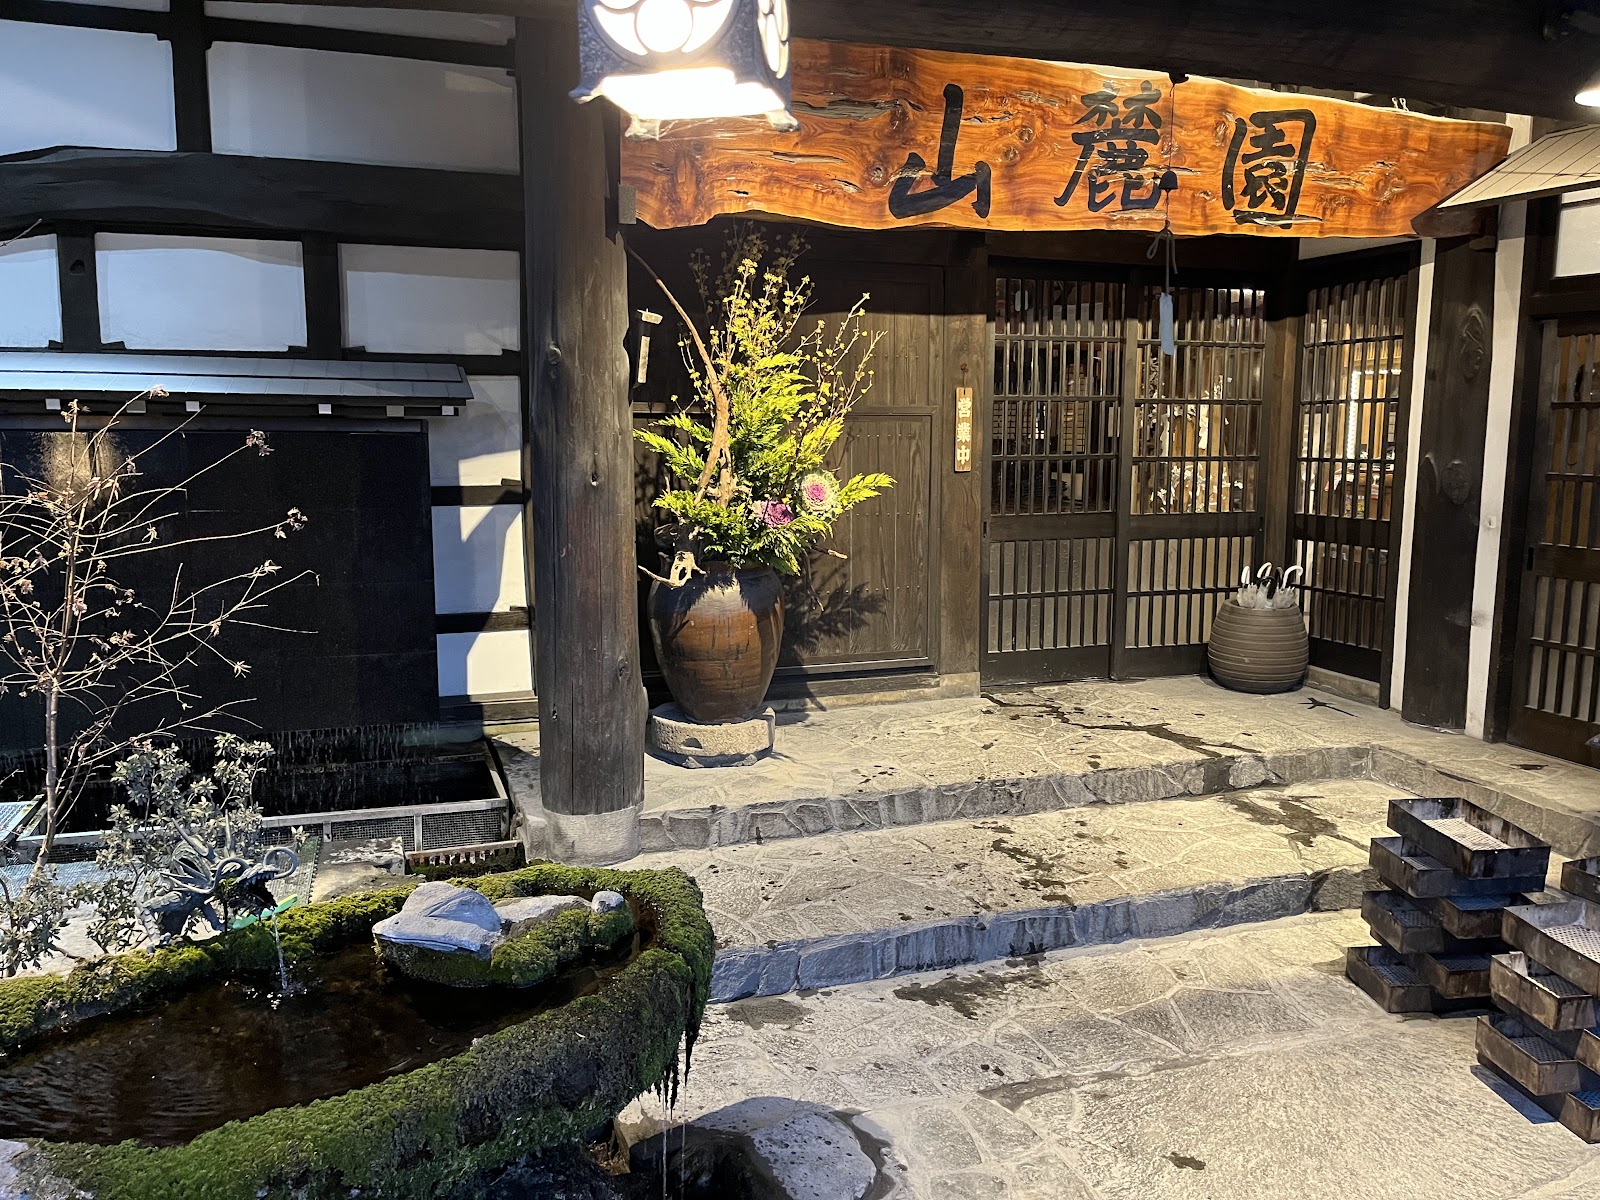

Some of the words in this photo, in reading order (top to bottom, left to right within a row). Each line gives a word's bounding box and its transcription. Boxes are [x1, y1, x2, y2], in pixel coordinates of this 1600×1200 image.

[889, 80, 1322, 229] 山麓園
[956, 397, 972, 465] 営業中
